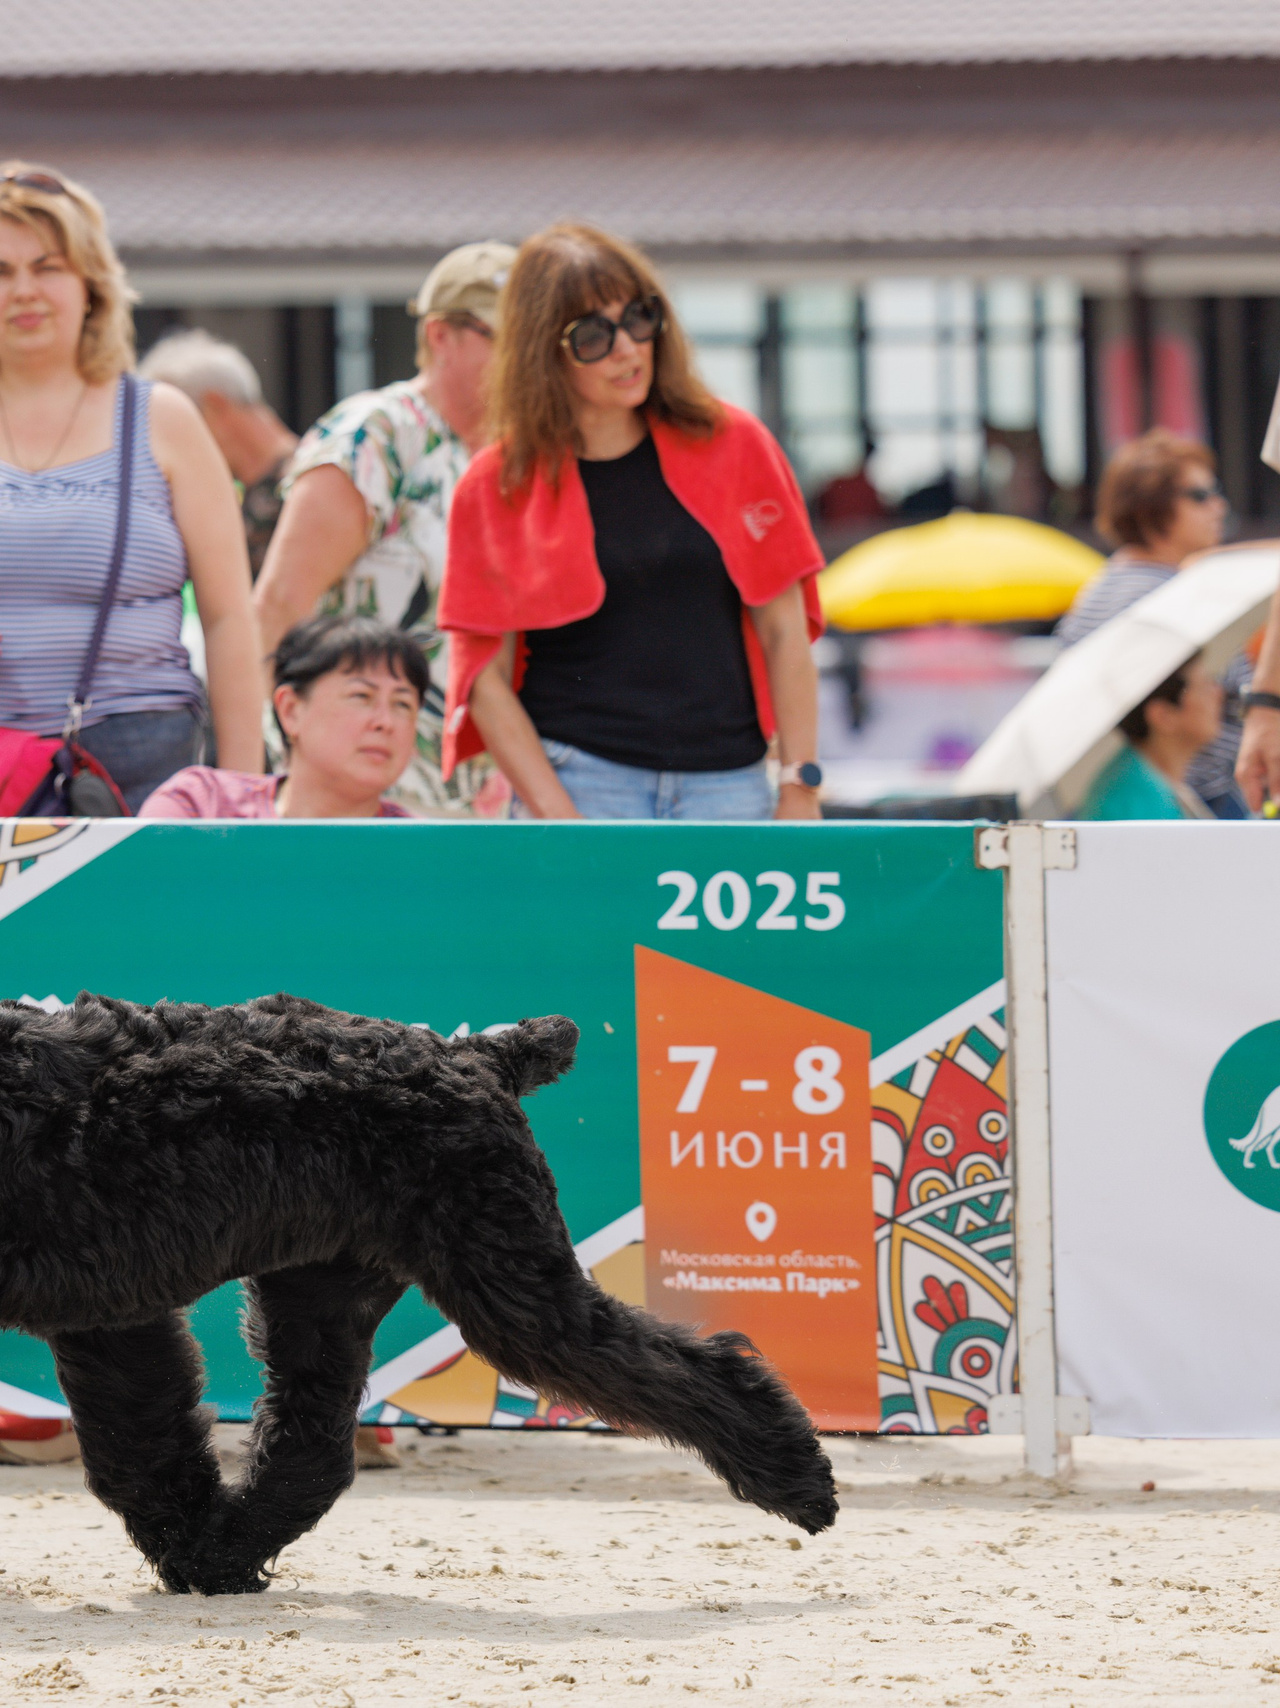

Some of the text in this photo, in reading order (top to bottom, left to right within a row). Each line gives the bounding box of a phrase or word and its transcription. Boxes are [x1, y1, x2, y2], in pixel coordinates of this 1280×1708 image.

[657, 870, 846, 931] 2025
[667, 1045, 718, 1114] 7
[792, 1045, 845, 1115] 8
[670, 1130, 847, 1169] ИЮНЯ
[660, 1249, 862, 1270] Московская область,
[662, 1271, 861, 1299] «Максима Парк»
